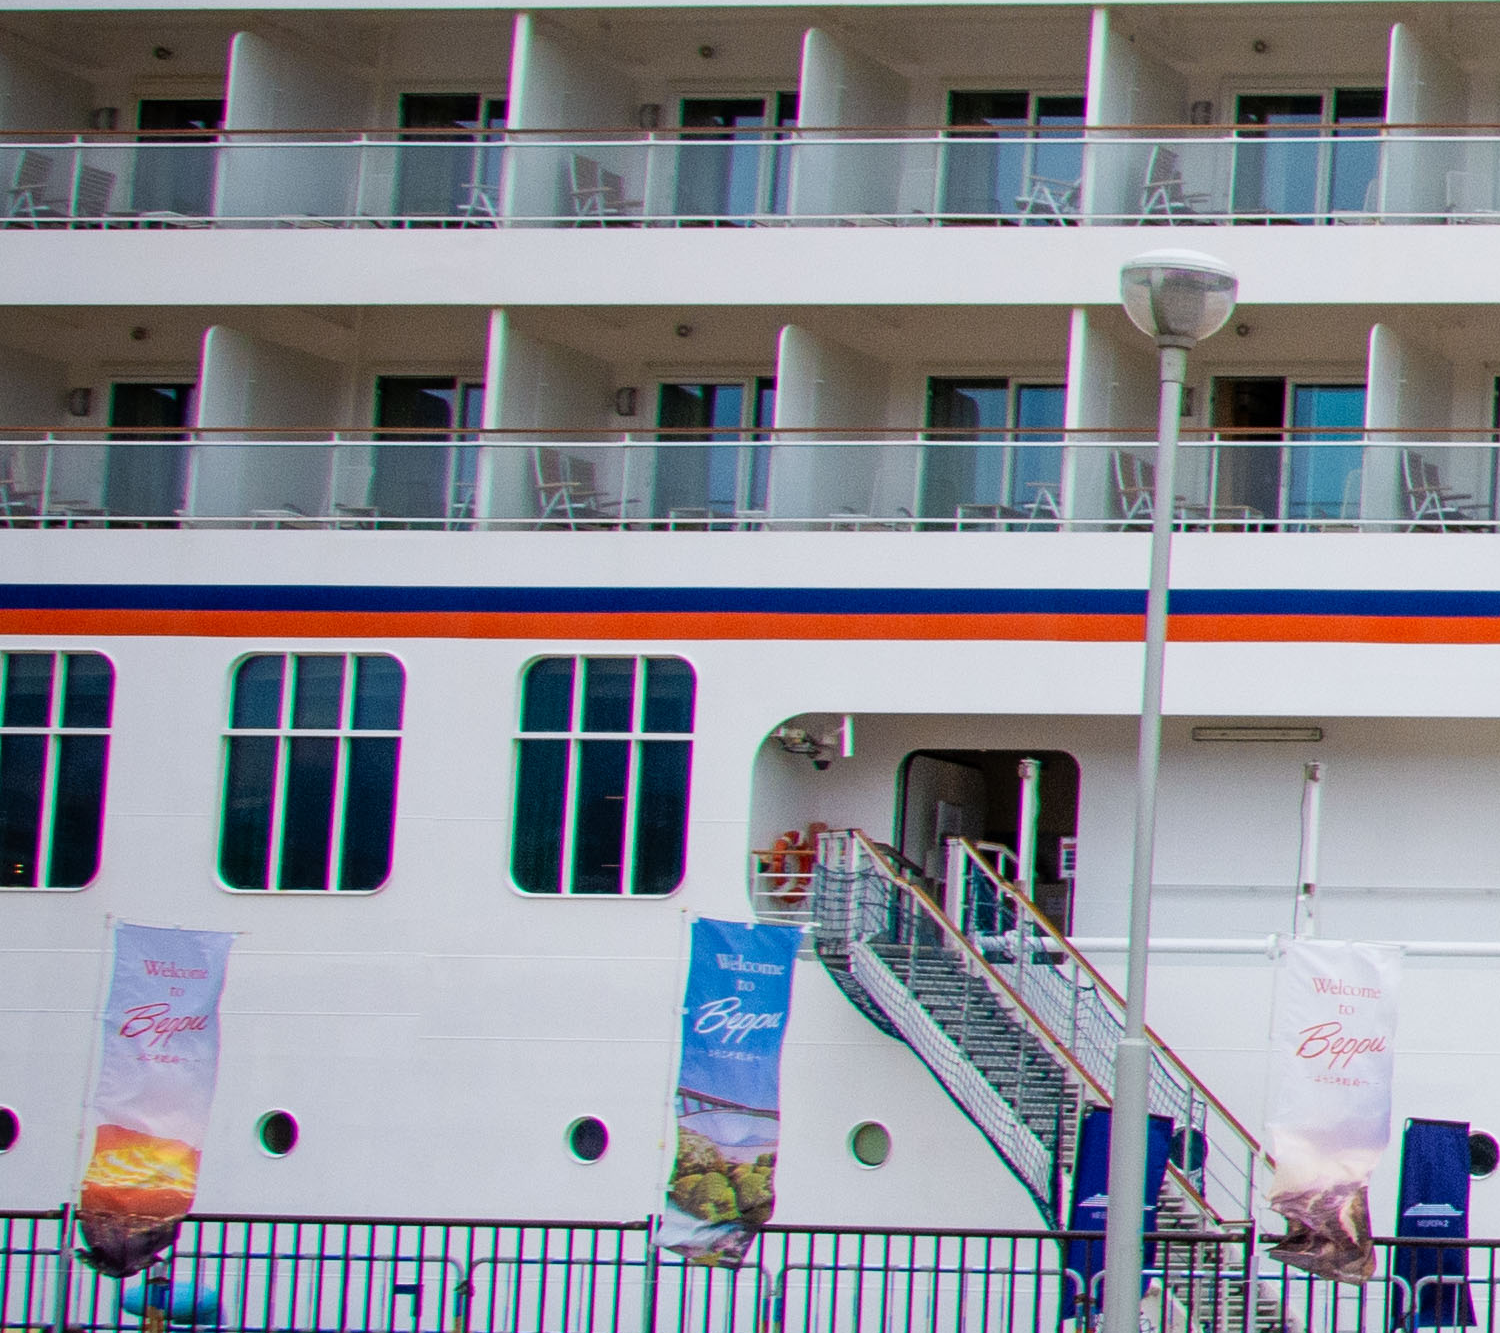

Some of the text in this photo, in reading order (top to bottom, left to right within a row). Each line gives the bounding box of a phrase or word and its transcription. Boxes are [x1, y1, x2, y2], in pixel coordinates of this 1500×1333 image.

[716, 953, 785, 975] Welcome
[736, 979, 755, 991] to
[1312, 977, 1382, 999] Welcome
[695, 996, 784, 1043] Beppu
[1338, 1004, 1355, 1015] to
[120, 1002, 208, 1047] Beppu
[1296, 1021, 1386, 1070] Beppu
